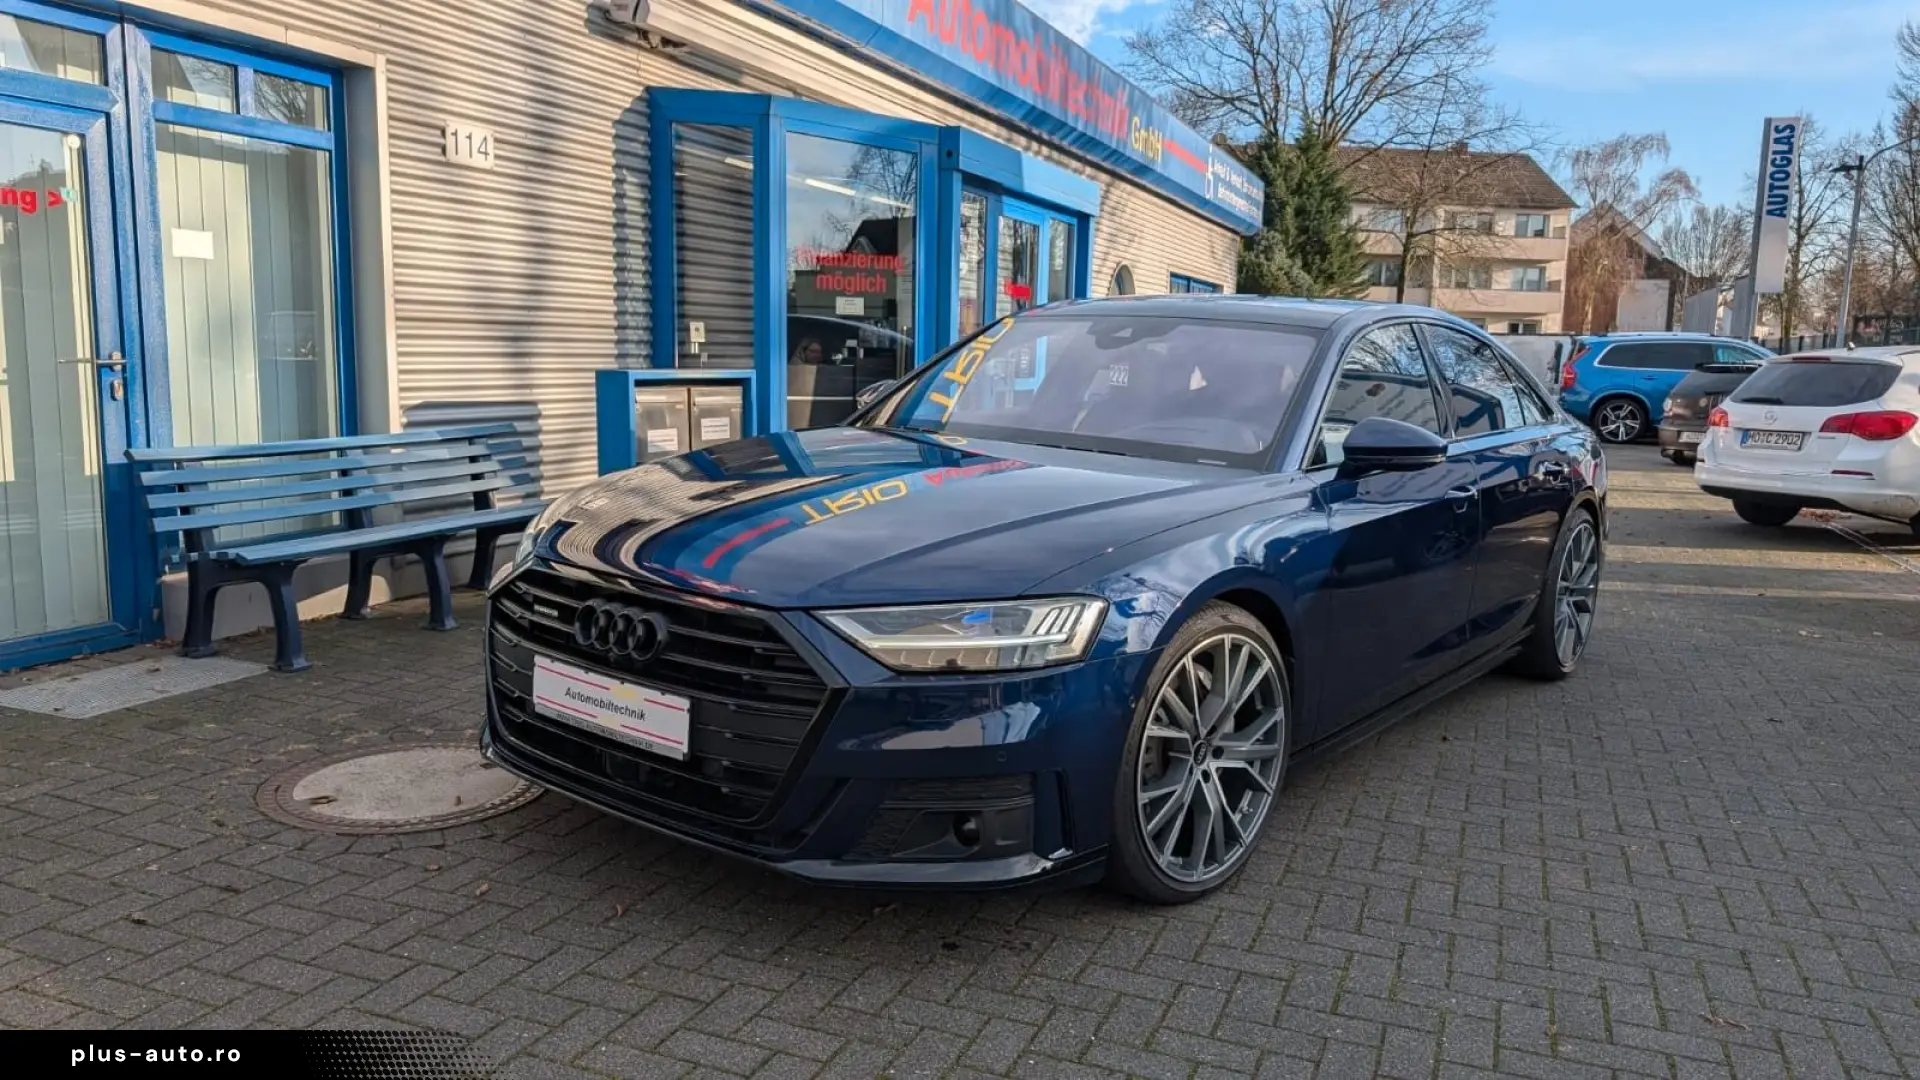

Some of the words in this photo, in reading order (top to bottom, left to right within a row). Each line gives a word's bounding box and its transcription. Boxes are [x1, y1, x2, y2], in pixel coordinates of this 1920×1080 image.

[450, 127, 490, 161] 114
[1132, 115, 1162, 164] GmbH
[1765, 124, 1796, 218] AUTOGLAS
[816, 271, 887, 295] möglich
[1774, 432, 1801, 446] 2902
[564, 686, 647, 722] Automobiltechnik
